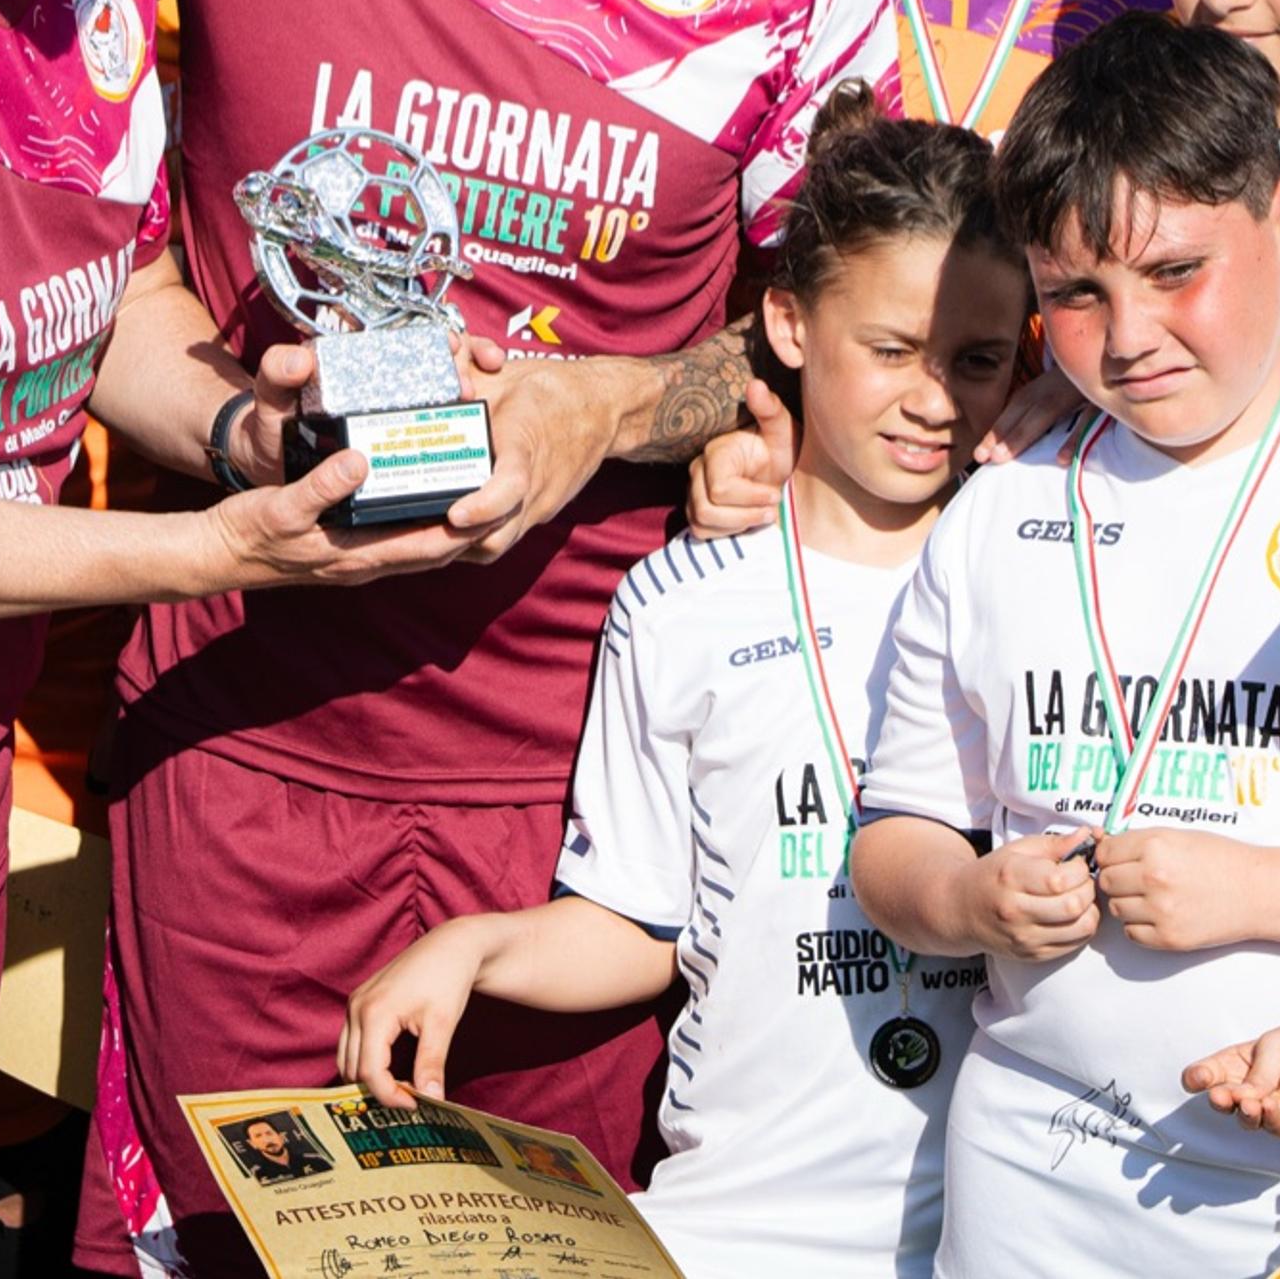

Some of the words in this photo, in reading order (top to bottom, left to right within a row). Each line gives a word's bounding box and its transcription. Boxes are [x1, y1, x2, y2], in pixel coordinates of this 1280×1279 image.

[309, 61, 373, 149] LA
[394, 79, 661, 209] GIORNATA
[462, 241, 580, 282] Quaglieri
[19, 237, 137, 365] GIORNAT
[4, 436, 19, 454] di
[20, 418, 56, 449] Mario
[1026, 669, 1066, 736] LA
[1027, 742, 1062, 792] DEL
[776, 763, 828, 827] LA
[1055, 797, 1070, 813] di
[1137, 803, 1238, 825] Quaglieri
[780, 831, 830, 880] DEL
[827, 884, 846, 899] di
[795, 928, 889, 963] STUDIO
[797, 959, 890, 997] MATTO
[388, 1146, 459, 1164] EDIZIONE
[275, 1195, 406, 1226] ATTESTATO
[410, 1192, 437, 1210] DI
[439, 1191, 626, 1228] PARTECIPAZIONE
[418, 1209, 498, 1227] rilasciato
[500, 1213, 512, 1225] a
[423, 1228, 489, 1246] DIEGO
[505, 1226, 577, 1248] ROSATO
